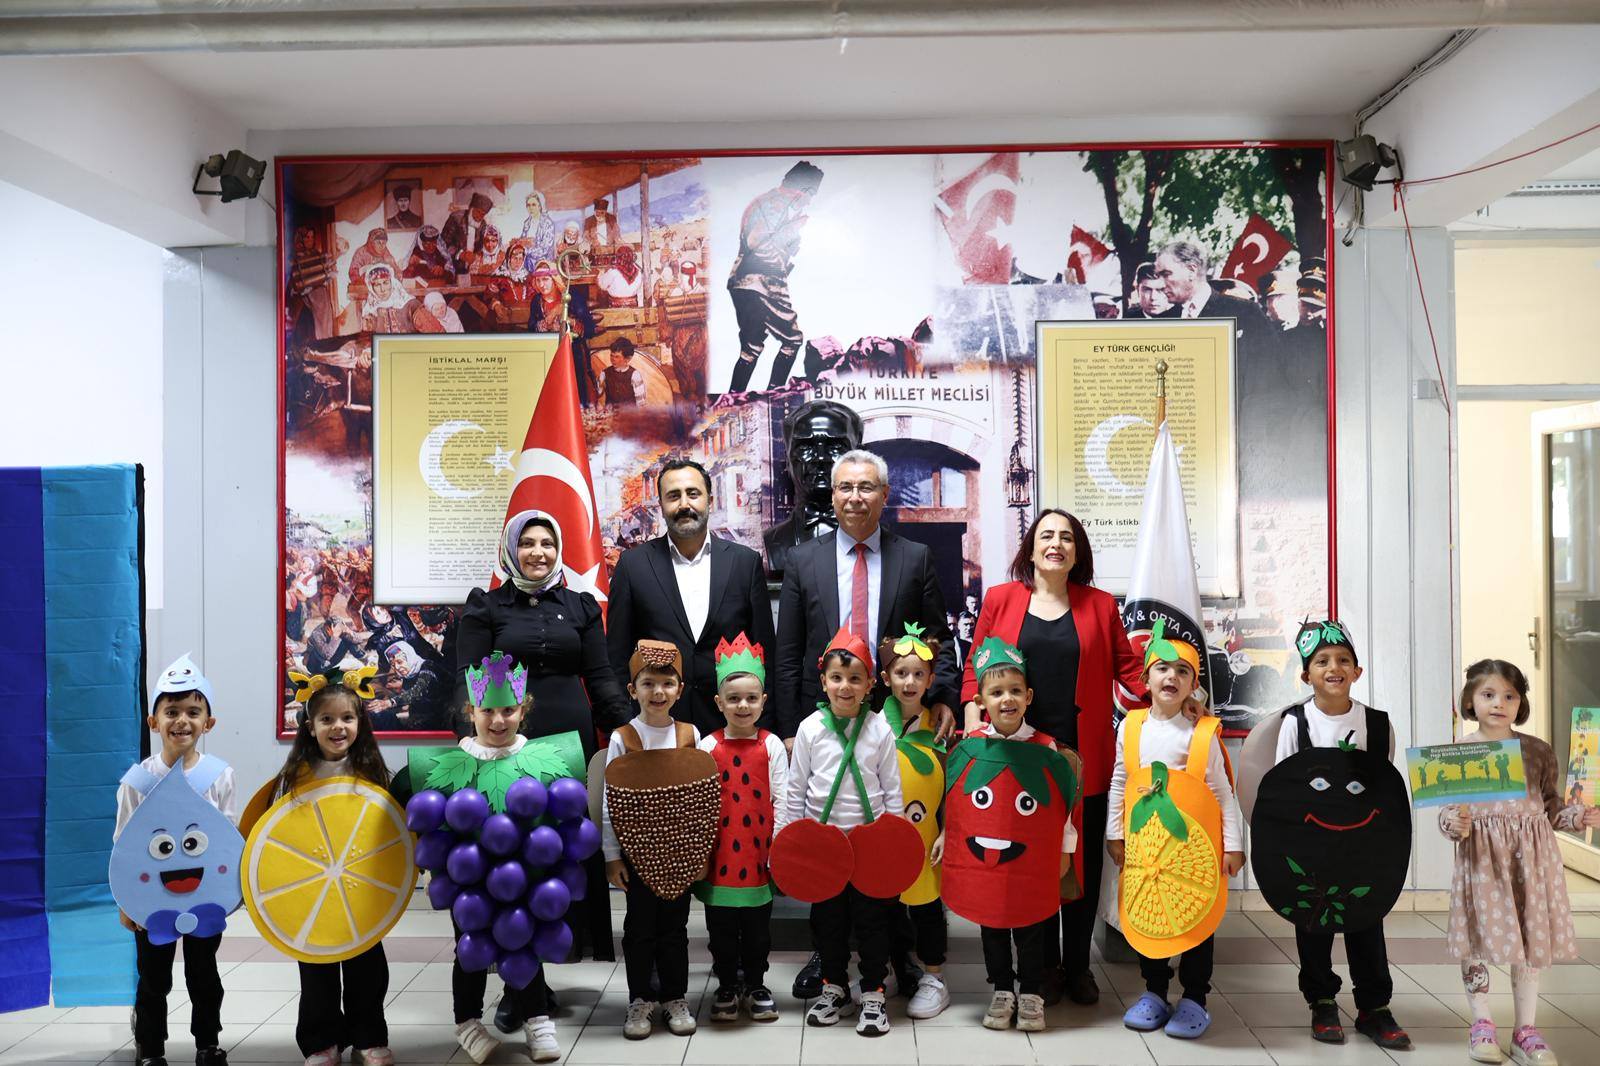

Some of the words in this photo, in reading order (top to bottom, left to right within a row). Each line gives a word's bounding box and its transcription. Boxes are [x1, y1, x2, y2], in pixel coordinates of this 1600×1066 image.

[1093, 345, 1105, 353] EY
[1108, 345, 1131, 353] TÜRK
[1132, 344, 1176, 353] GENÇLİĞİ!
[475, 356, 507, 365] MARŞI
[814, 383, 867, 400] BÜYÜK
[874, 384, 925, 401] MİLLET
[931, 384, 990, 402] MECLİSİ
[1081, 518, 1092, 526] Ey
[1094, 518, 1114, 526] Türk
[1115, 518, 1139, 526] istikb
